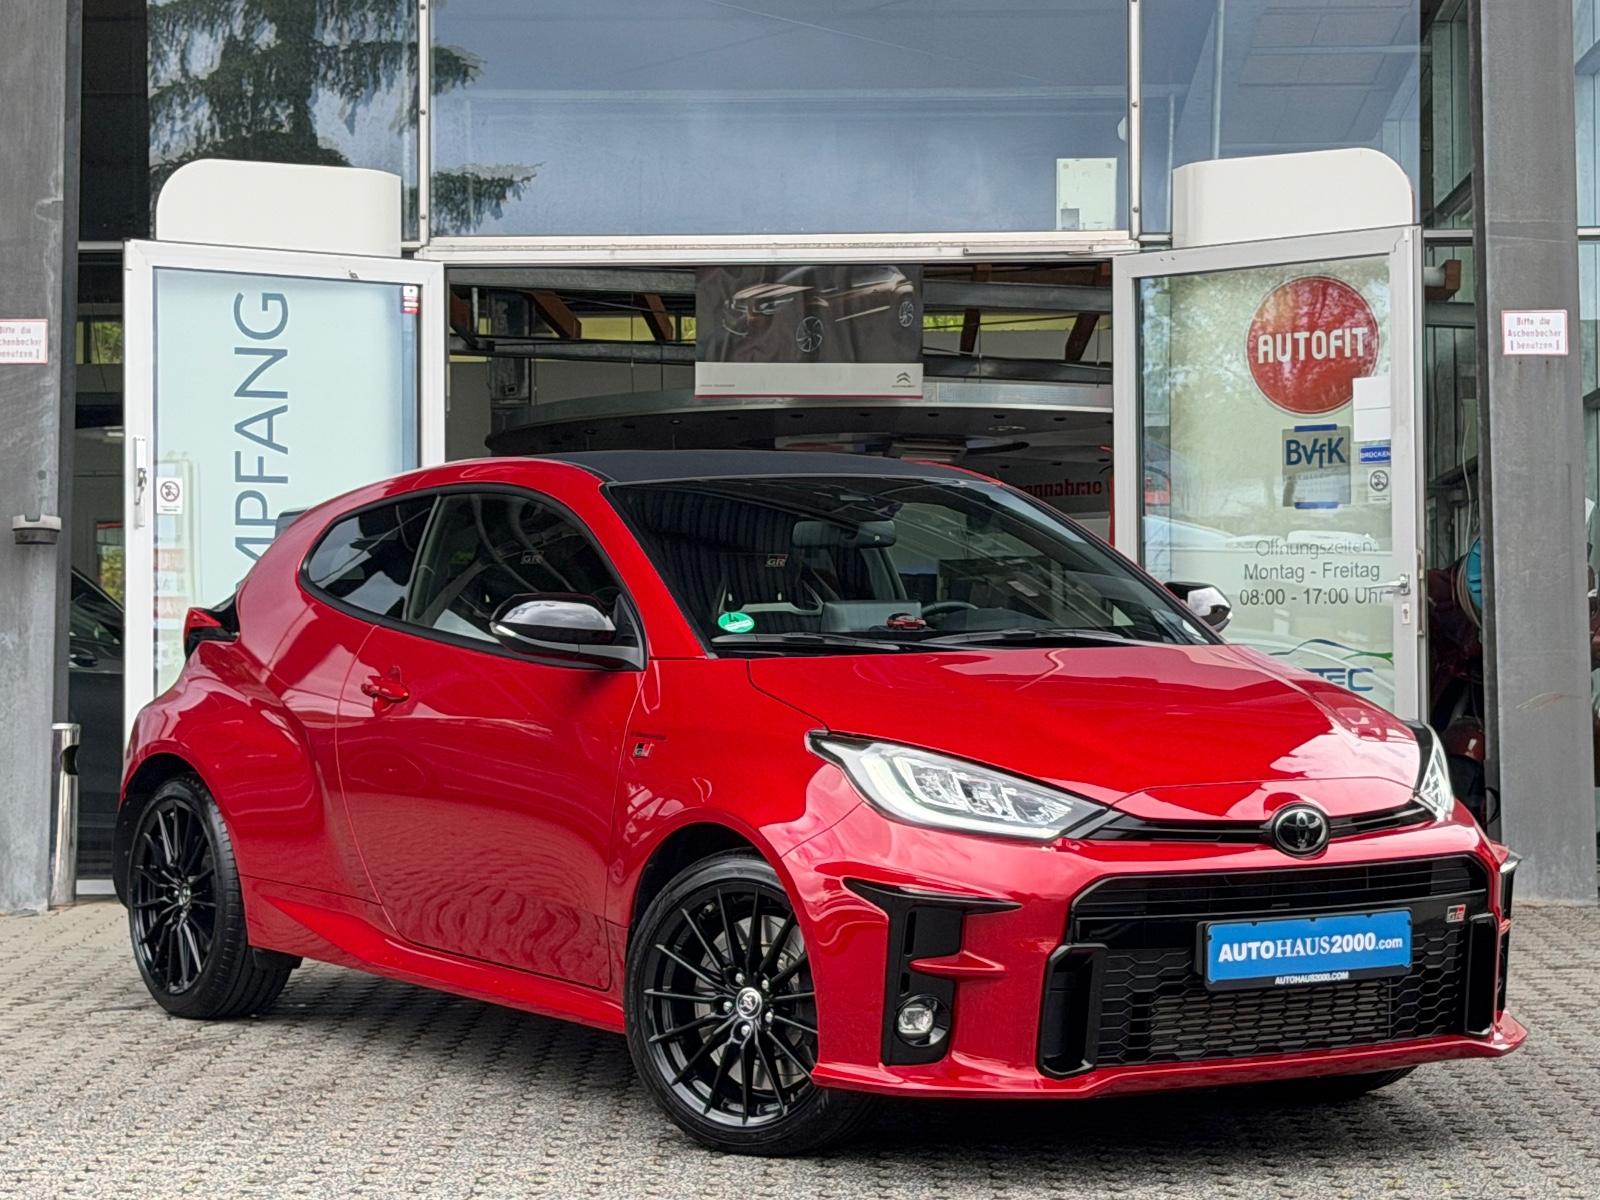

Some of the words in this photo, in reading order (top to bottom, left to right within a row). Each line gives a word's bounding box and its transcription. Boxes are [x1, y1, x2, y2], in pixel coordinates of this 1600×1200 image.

[1507, 328, 1561, 338] Aschenbecher
[1258, 327, 1368, 364] AUTOFIT
[1244, 563, 1305, 583] Montag
[1323, 561, 1380, 582] Freitag
[1240, 588, 1285, 606] 08:00
[1303, 587, 1349, 605] 17:00
[1355, 587, 1383, 604] Uhr
[1218, 932, 1403, 962] AUTOHAUS2000.com
[1275, 971, 1349, 985] AUTOHAUS2000.COM
